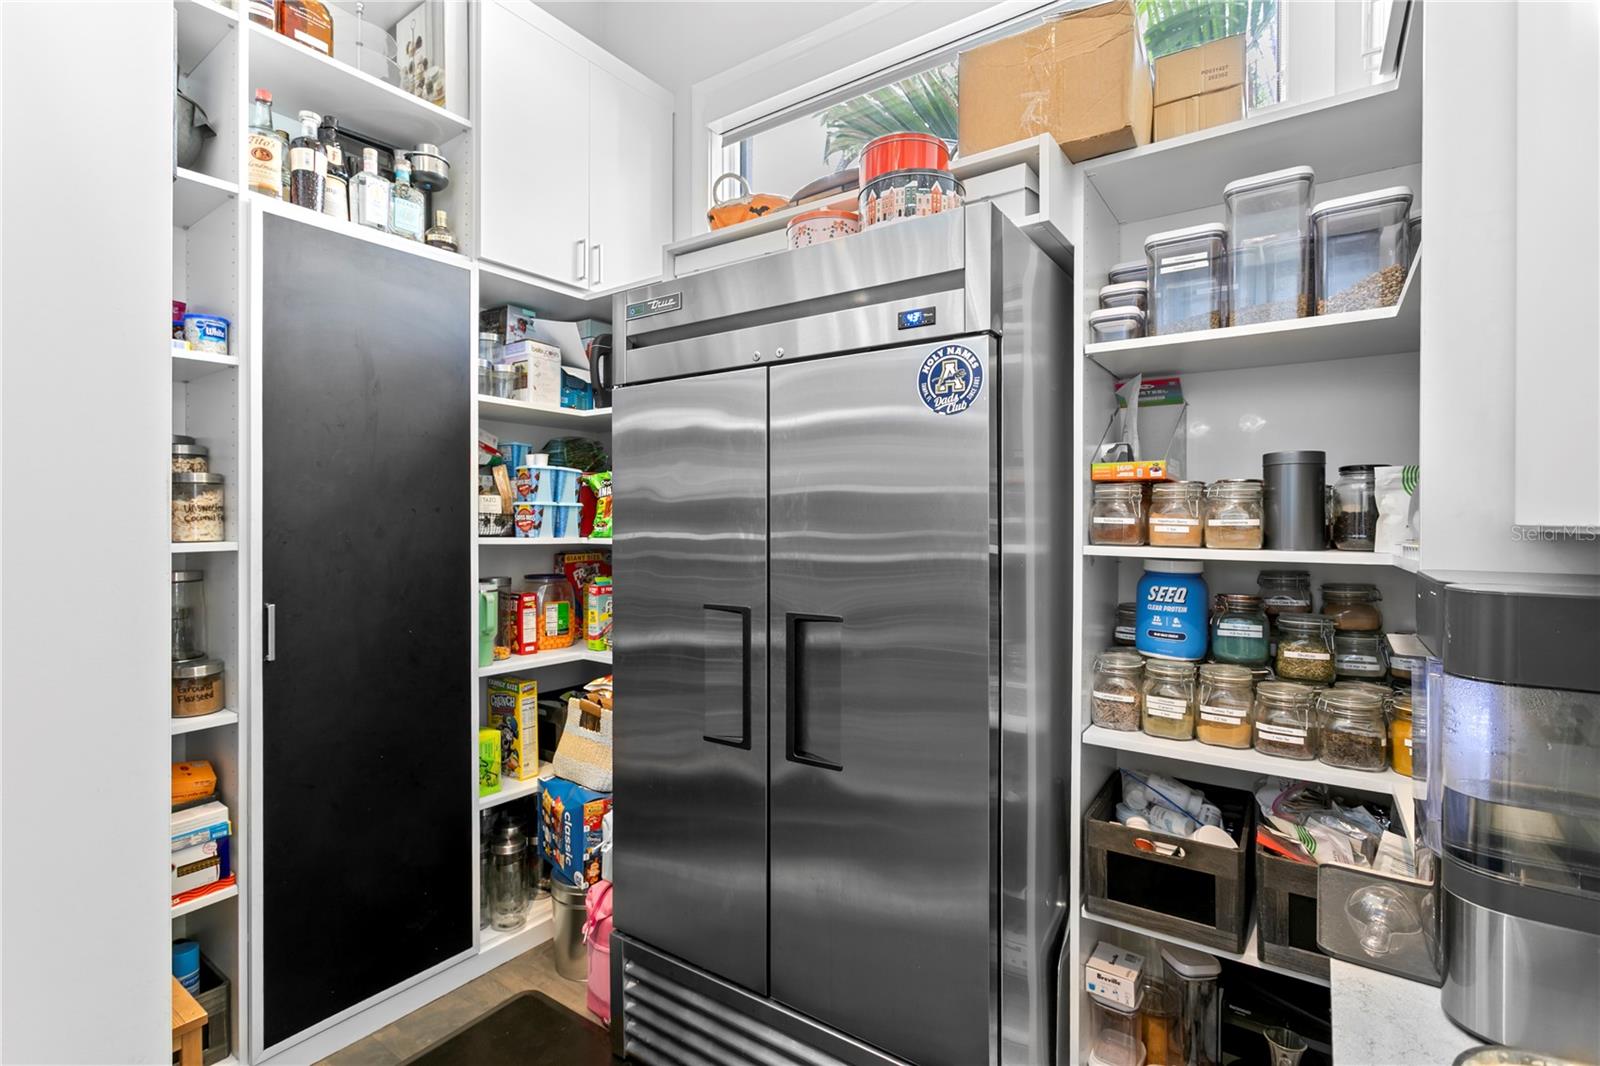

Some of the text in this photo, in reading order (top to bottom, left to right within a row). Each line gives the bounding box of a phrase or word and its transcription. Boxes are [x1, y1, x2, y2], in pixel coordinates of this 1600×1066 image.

[921, 346, 980, 374] HOLY NAMES
[934, 393, 960, 407] Dads
[946, 400, 968, 414] Club
[566, 554, 585, 562] GIANT
[1147, 586, 1187, 604] SEEQ
[1163, 605, 1187, 613] PROTEIN
[564, 811, 573, 866] classic
[1096, 973, 1121, 986] Breville
